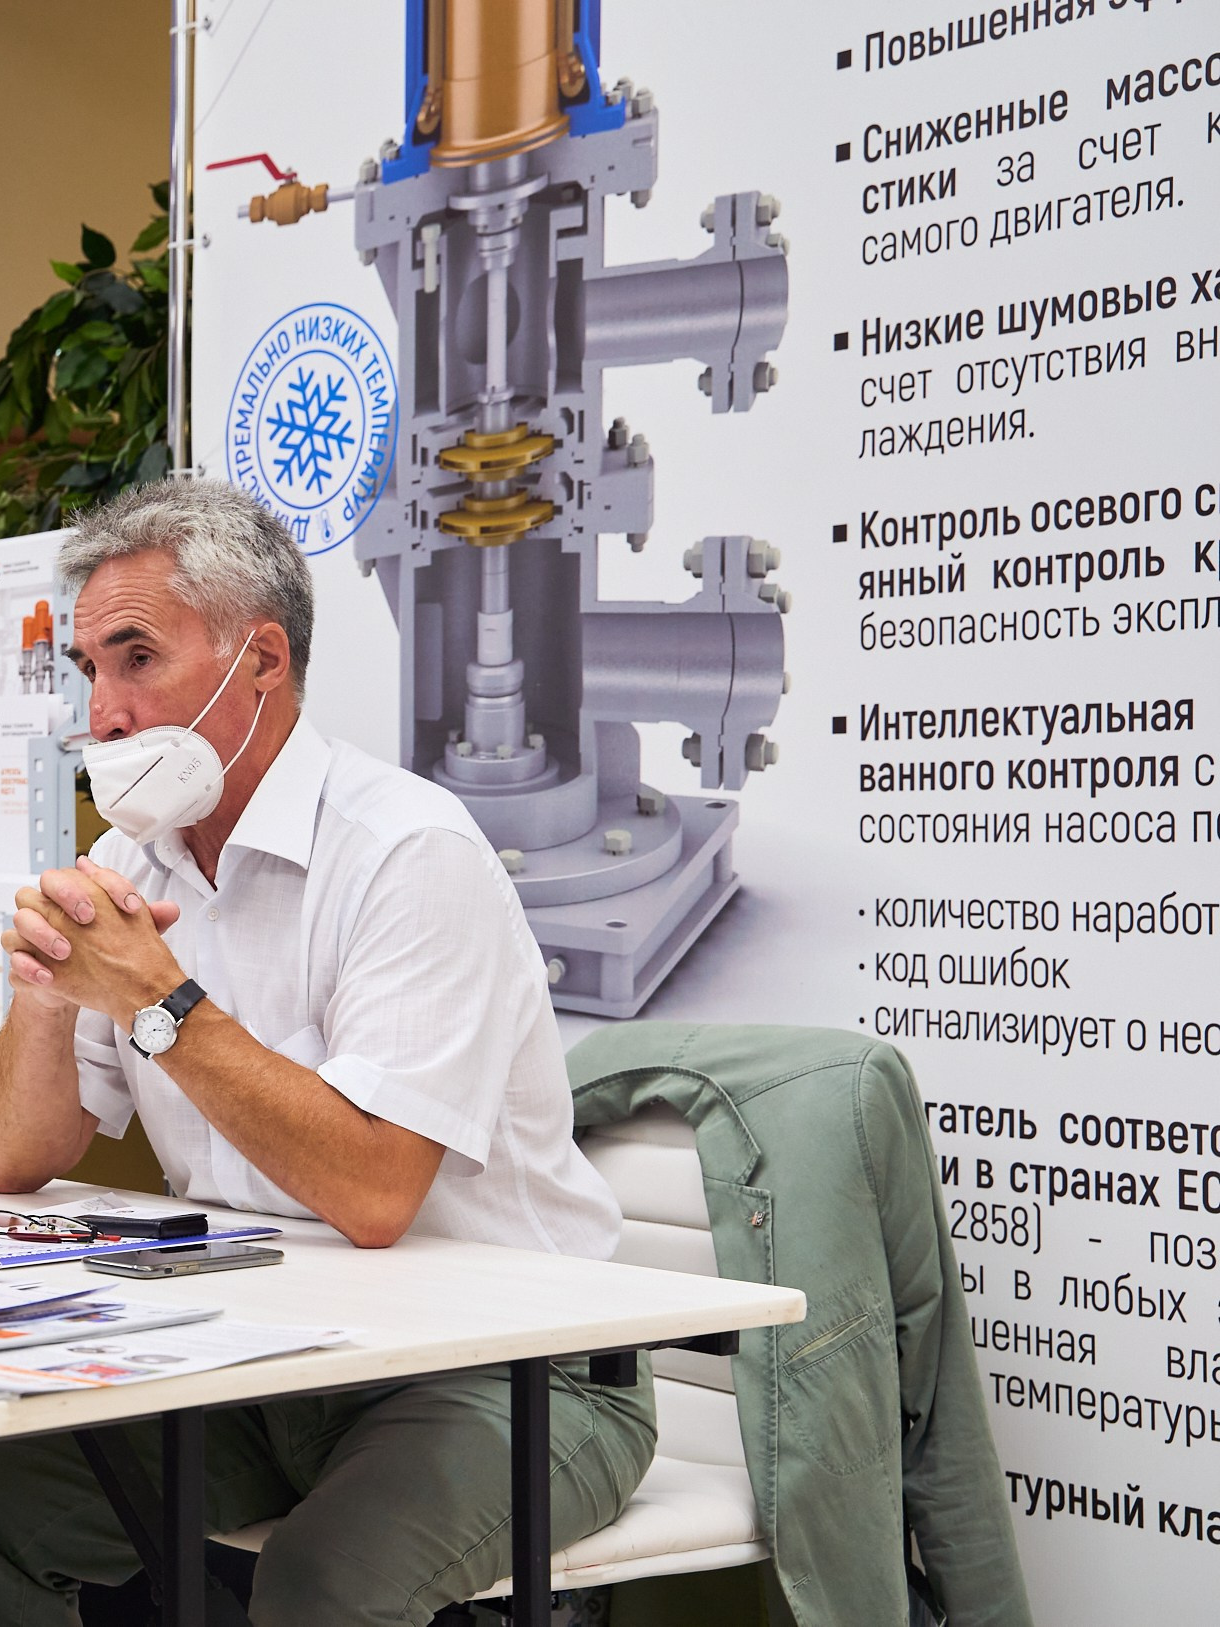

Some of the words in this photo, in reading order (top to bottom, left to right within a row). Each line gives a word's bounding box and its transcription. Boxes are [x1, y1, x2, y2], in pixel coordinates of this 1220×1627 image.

[865, 0, 1095, 73] Повышенная
[863, 89, 1068, 163] Сниженные
[1106, 52, 1220, 110] массо
[862, 167, 956, 215] стики
[996, 151, 1035, 187] за
[1078, 122, 1162, 170] счет
[862, 216, 978, 266] самого
[989, 176, 1184, 249] двигателя.
[862, 309, 984, 357] Низкие
[998, 276, 1177, 341] шумовые
[861, 369, 933, 408] счет
[956, 336, 1146, 397] отсутствия
[1176, 325, 1218, 363] вн
[295, 315, 368, 363] НИЗКИХ
[343, 352, 391, 522] ТЕМПЕРАТУР
[858, 408, 1035, 459] лаждения.
[861, 505, 1021, 551] Контроль
[1031, 487, 1182, 533] осевого
[1195, 483, 1216, 517] с
[859, 552, 965, 600] янный
[993, 545, 1165, 593] контроль
[860, 606, 1100, 651] безопасность
[1113, 596, 1220, 635] экспл
[860, 698, 1194, 746] Интеллектуальная
[177, 757, 202, 785] KN95
[860, 759, 994, 793] ванного
[1008, 755, 1179, 799] контроля
[1195, 753, 1215, 787] с
[859, 812, 1030, 844] состояния
[1045, 810, 1176, 844] насоса
[1193, 810, 1220, 843] п
[875, 897, 1059, 932] количество
[1072, 890, 1220, 943] наработ
[875, 952, 929, 989] код
[939, 945, 1071, 989] ошибок
[875, 1006, 1116, 1057] сигнализирует
[1126, 1019, 1147, 1052] о
[924, 1101, 1037, 1140] гатель
[976, 1158, 994, 1189] в
[1009, 1161, 1161, 1208] странах
[950, 1199, 1041, 1255] 2858)
[1150, 1231, 1217, 1270] поз
[1014, 1269, 1032, 1301] в
[1058, 1272, 1187, 1324] любых
[1004, 1470, 1145, 1529] турный
